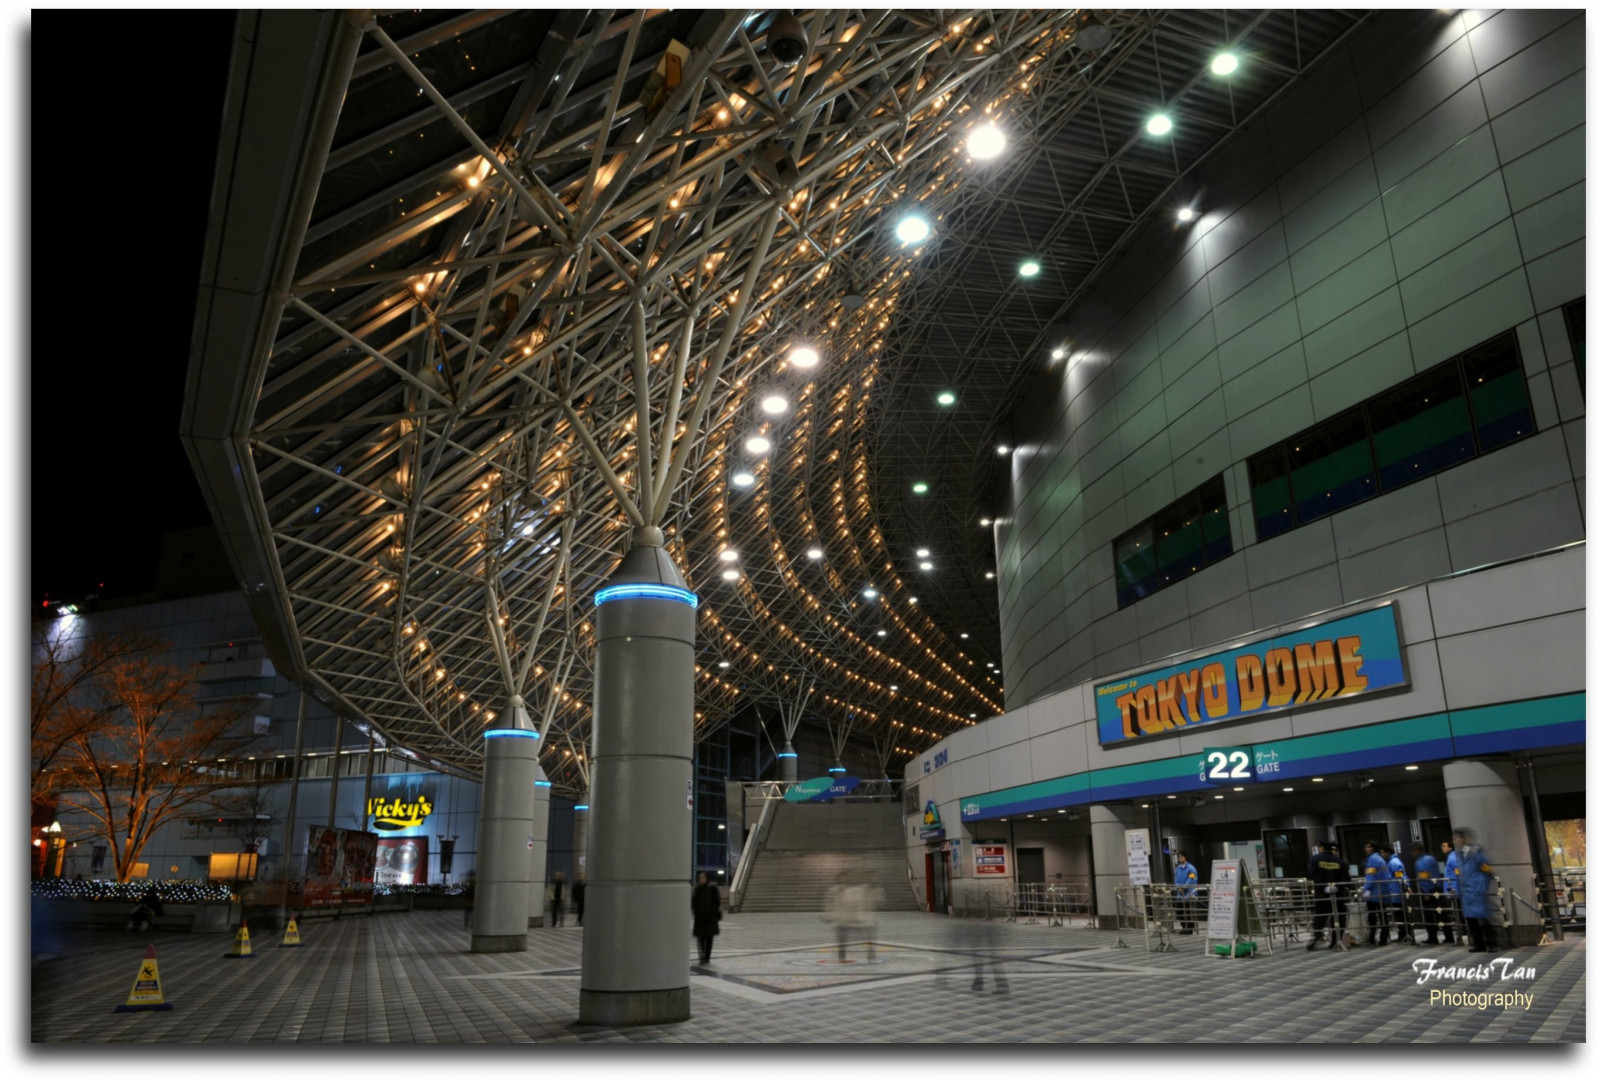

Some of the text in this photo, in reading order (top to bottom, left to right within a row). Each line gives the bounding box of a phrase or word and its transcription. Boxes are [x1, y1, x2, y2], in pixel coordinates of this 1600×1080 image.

[1098, 680, 1138, 696] Welcome to
[1116, 635, 1368, 738] TOKYO DOME
[1255, 749, 1279, 763] ゲート
[1207, 751, 1251, 779] 22
[1256, 762, 1280, 774] GATE
[829, 785, 847, 793] GATE
[367, 795, 432, 827] Vicky's
